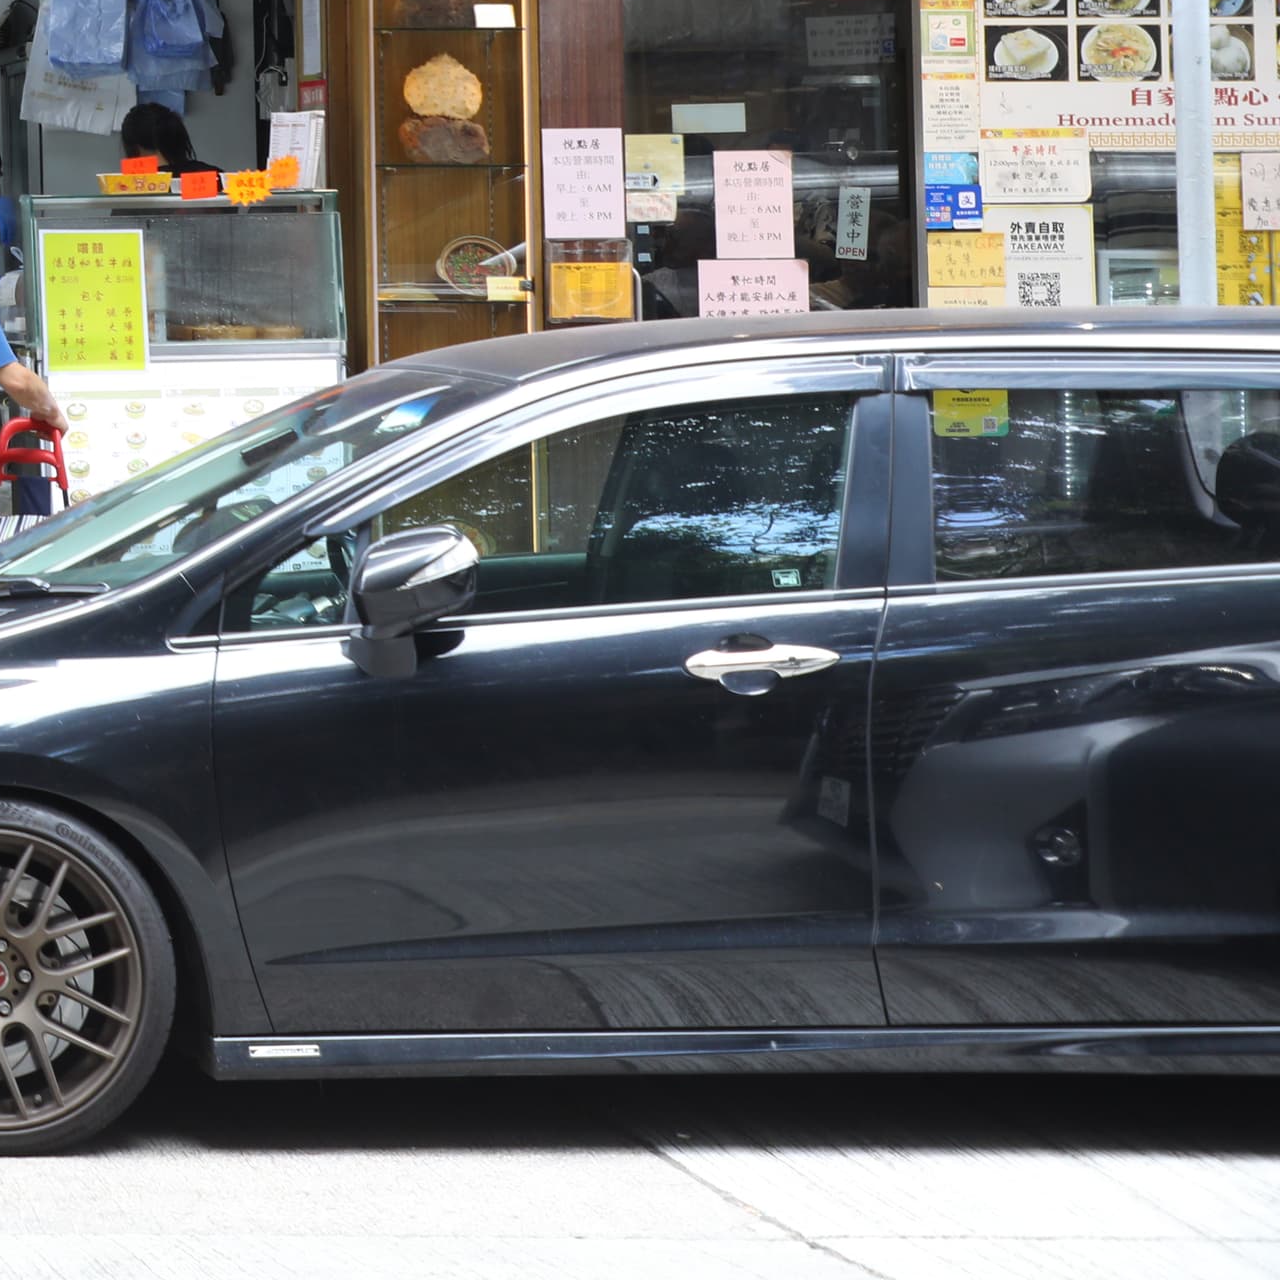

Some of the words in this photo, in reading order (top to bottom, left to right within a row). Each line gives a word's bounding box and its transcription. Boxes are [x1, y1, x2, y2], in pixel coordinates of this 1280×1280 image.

[595, 184, 612, 192] AM
[764, 205, 782, 213] AM
[596, 211, 612, 220] PM
[846, 193, 864, 244] 營業中
[1010, 221, 1065, 234] 外賣自取
[766, 232, 782, 240] PM
[1011, 242, 1065, 250] TAKEAWAY
[838, 246, 865, 257] OPEN
